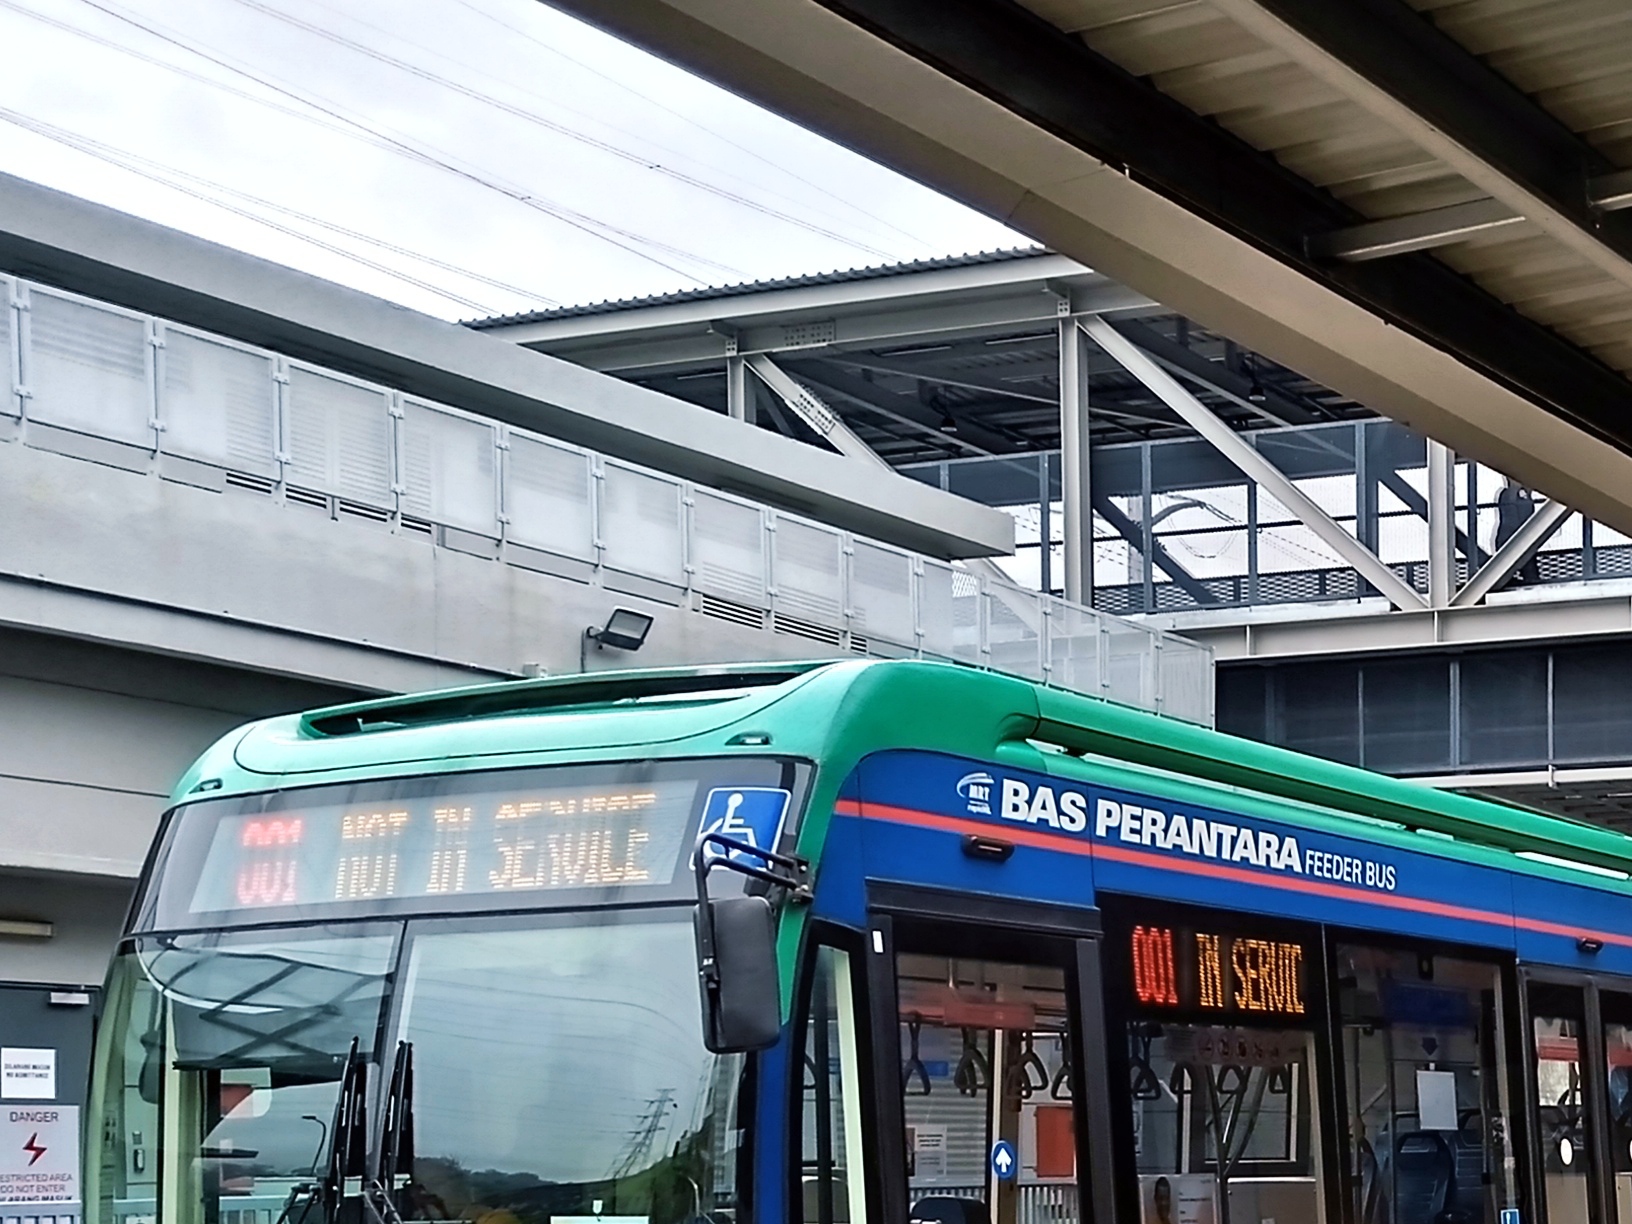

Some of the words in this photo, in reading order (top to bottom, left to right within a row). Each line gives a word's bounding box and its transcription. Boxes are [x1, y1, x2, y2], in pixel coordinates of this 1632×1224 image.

[336, 811, 408, 899] NOT
[426, 806, 472, 893] IN
[489, 792, 657, 889] SERVICE
[1001, 778, 1087, 832] BAS
[1096, 798, 1302, 873] PERANTARA
[1305, 849, 1362, 885] FEEDER
[1365, 859, 1396, 891] BUS
[1196, 932, 1224, 1008] IN
[9, 1111, 59, 1123] DANGER
[1, 1184, 14, 1193] DO
[16, 1184, 35, 1193] NOT
[36, 1184, 66, 1193] ENTER
[49, 1173, 73, 1181] AREA
